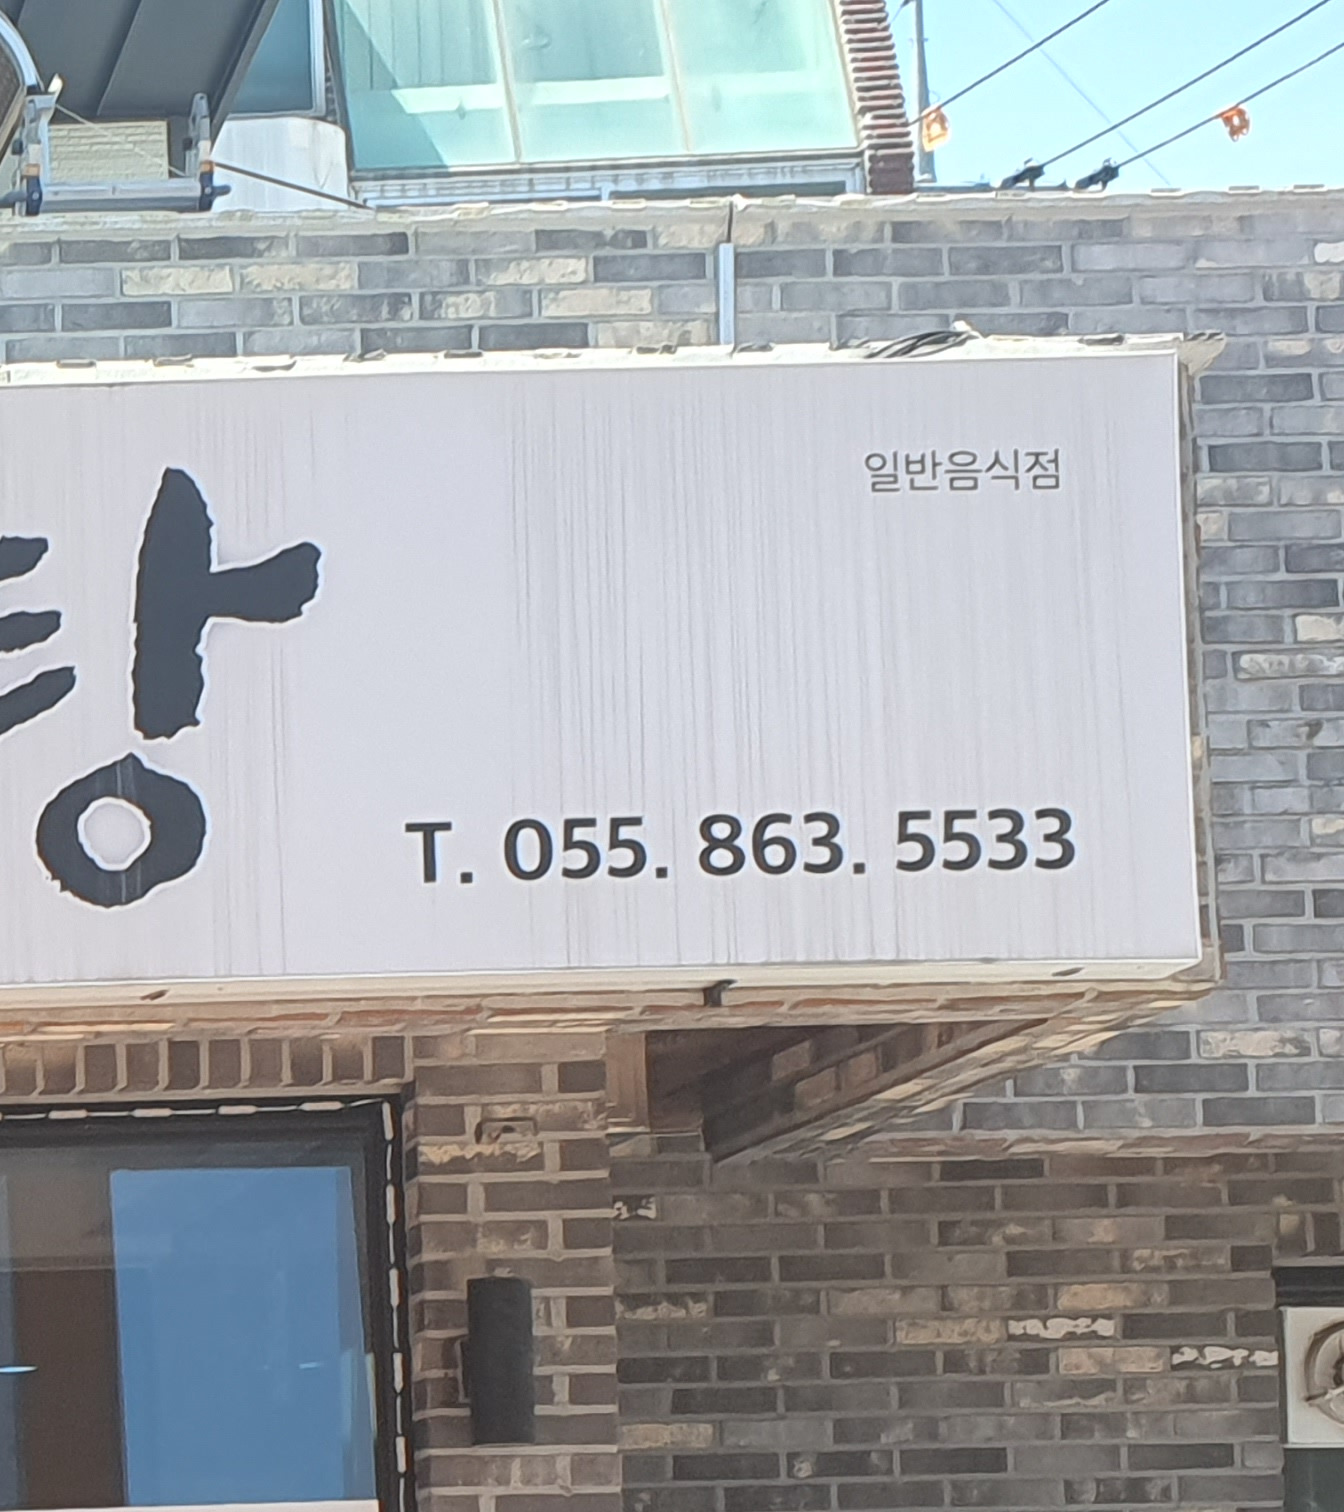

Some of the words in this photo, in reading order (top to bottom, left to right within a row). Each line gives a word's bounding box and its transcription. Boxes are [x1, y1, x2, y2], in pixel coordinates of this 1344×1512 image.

[863, 448, 1061, 493] 일반음식점
[406, 821, 473, 883] T.
[504, 817, 668, 880] 055.
[698, 813, 866, 876] 863.
[896, 808, 1075, 871] 5533
